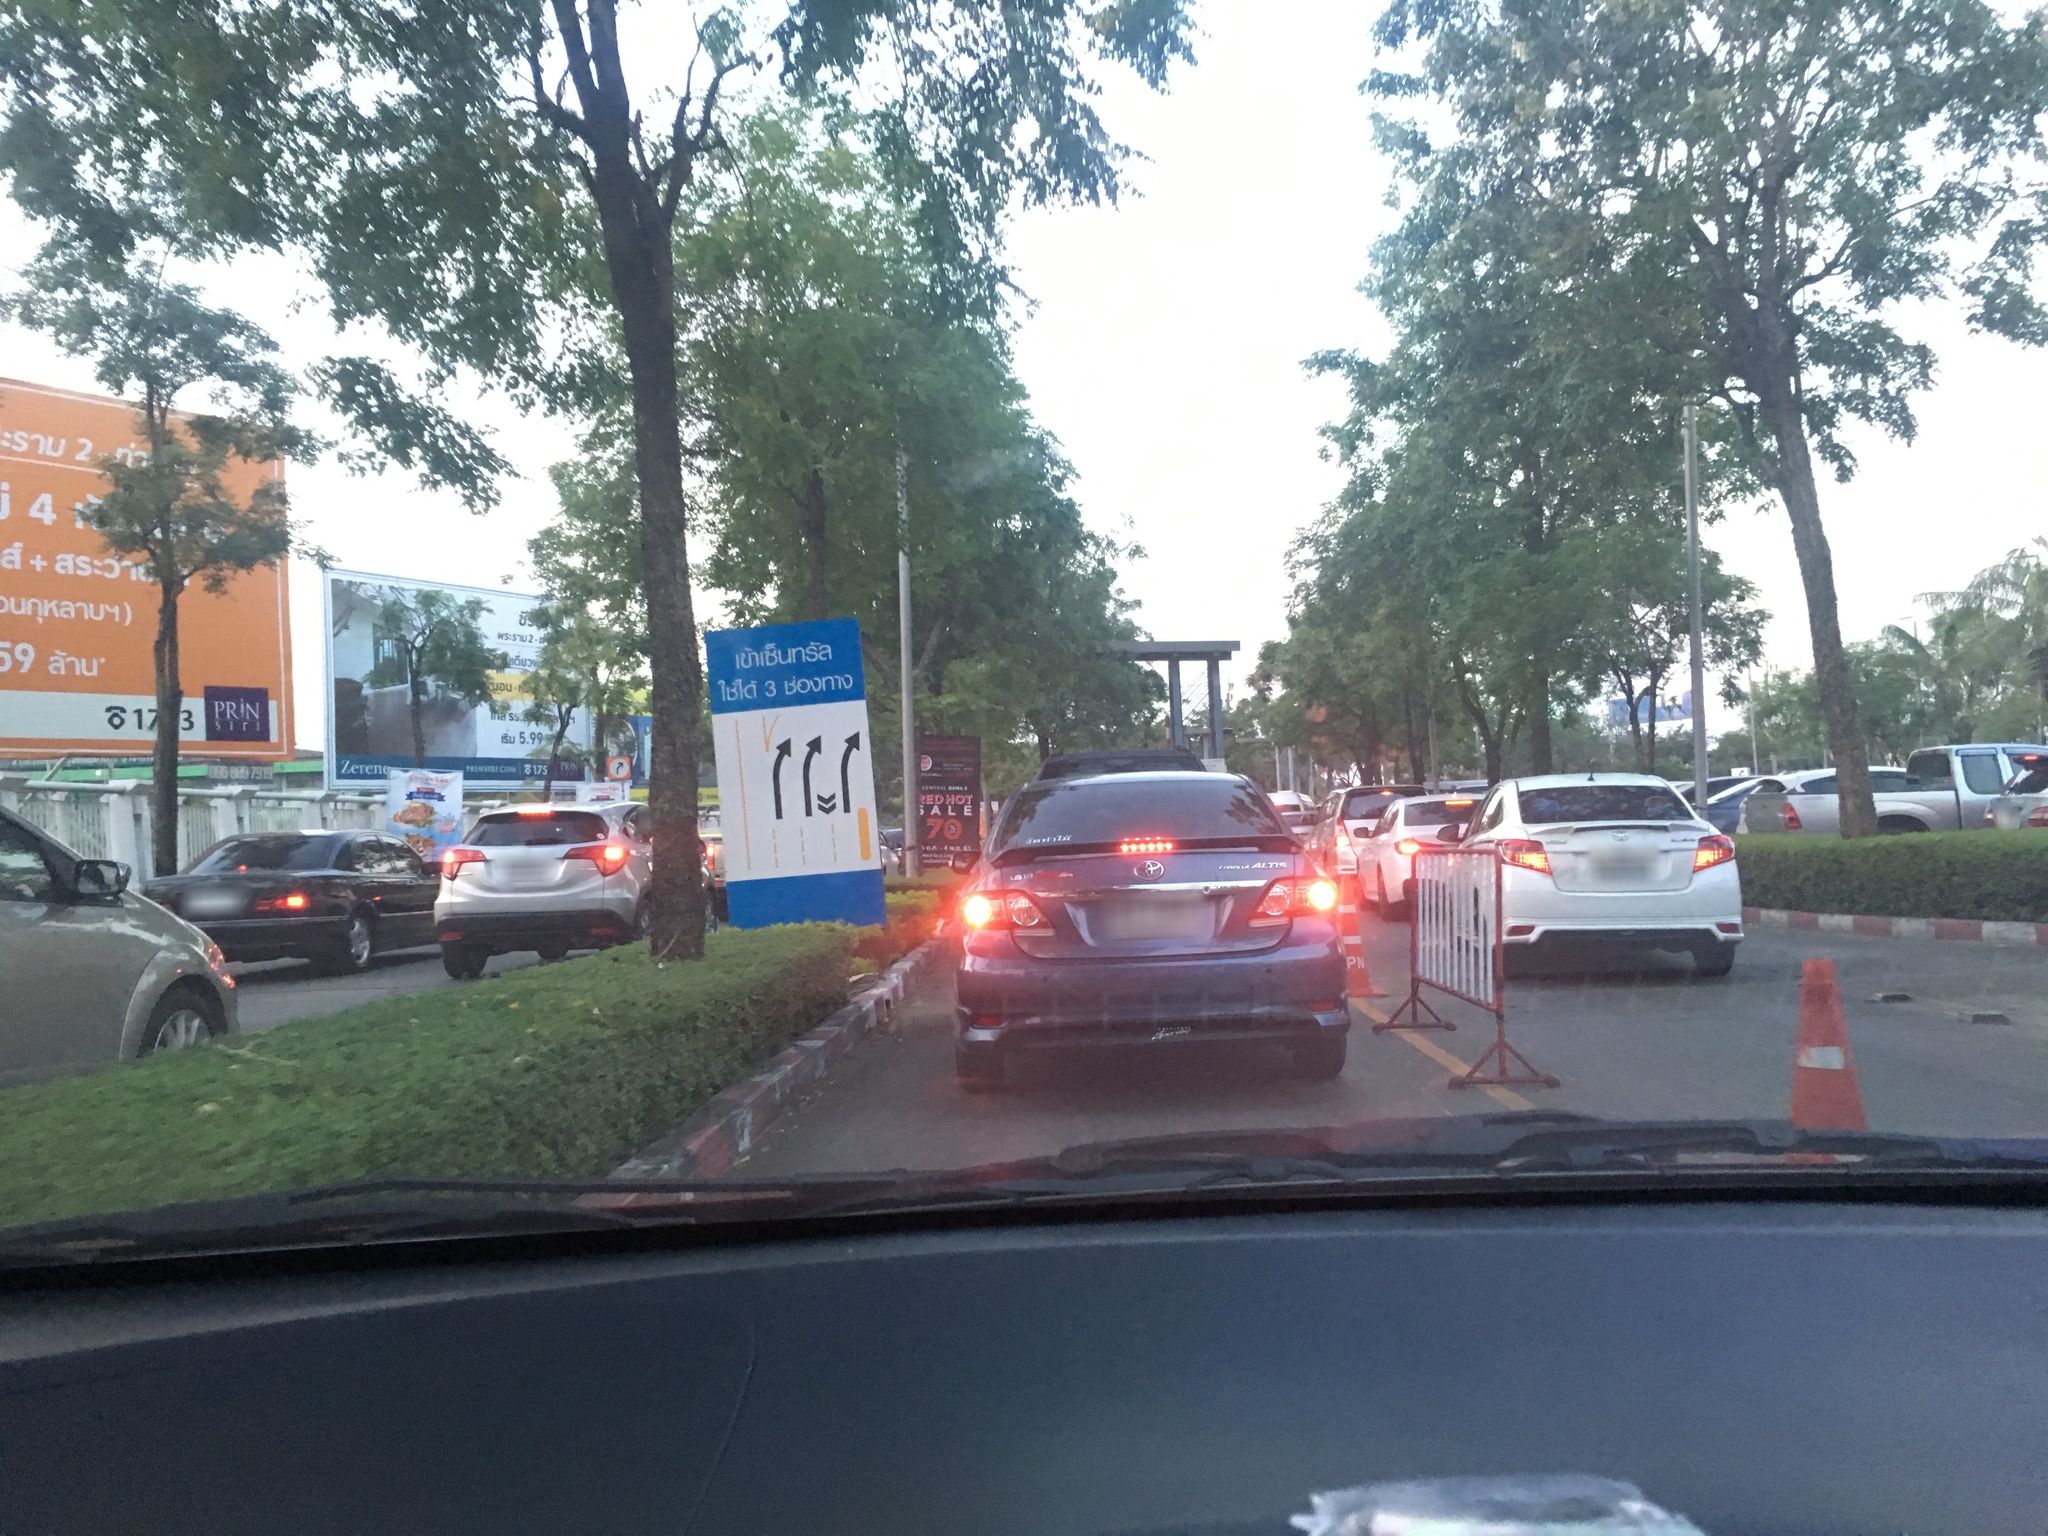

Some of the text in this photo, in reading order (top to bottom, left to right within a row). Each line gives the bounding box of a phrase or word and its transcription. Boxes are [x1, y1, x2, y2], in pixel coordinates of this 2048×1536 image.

[75, 438, 93, 461] 2
[28, 493, 56, 526] 4
[735, 641, 832, 669] เข้าเซ็นทรัล
[717, 673, 854, 701] ใช้ได้ 3 ช่องทาง
[133, 707, 195, 731] 173
[946, 794, 973, 805] HOT
[1346, 956, 1365, 969] PN
